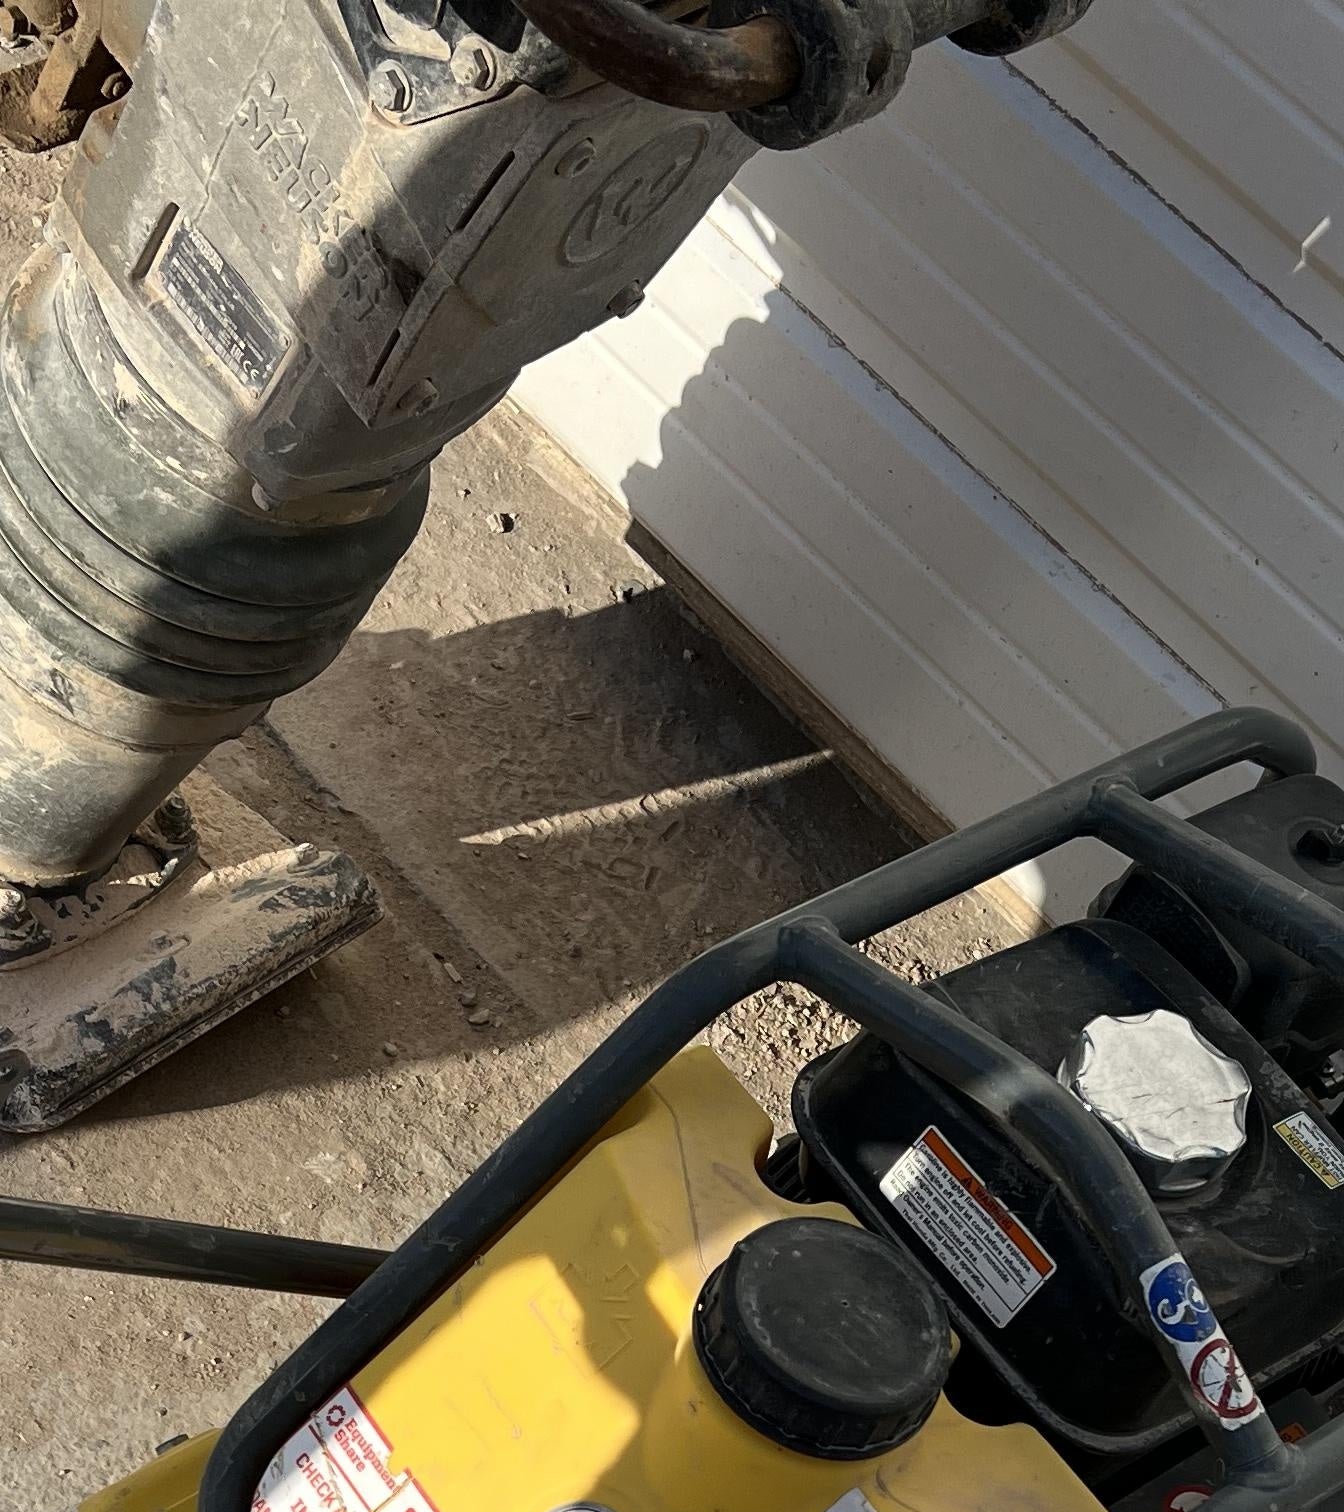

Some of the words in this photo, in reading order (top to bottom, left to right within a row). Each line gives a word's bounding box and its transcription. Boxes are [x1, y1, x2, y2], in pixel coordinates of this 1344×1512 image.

[1285, 1133, 1321, 1169] CAUTION
[918, 1142, 943, 1172] Gasoline
[946, 1175, 966, 1200] highly
[964, 1194, 997, 1231] flammable
[994, 1228, 1008, 1244] and
[923, 1165, 944, 1191] engine
[942, 1186, 953, 1200] off
[951, 1196, 964, 1212] and
[973, 1186, 1012, 1230] WARNING
[913, 1174, 933, 1198] engine
[962, 1228, 984, 1254] carbon
[938, 1217, 964, 1248] enclosed
[331, 1428, 369, 1473] Share
[341, 1418, 405, 1496] Equipment
[292, 1452, 340, 1508] CHECK
